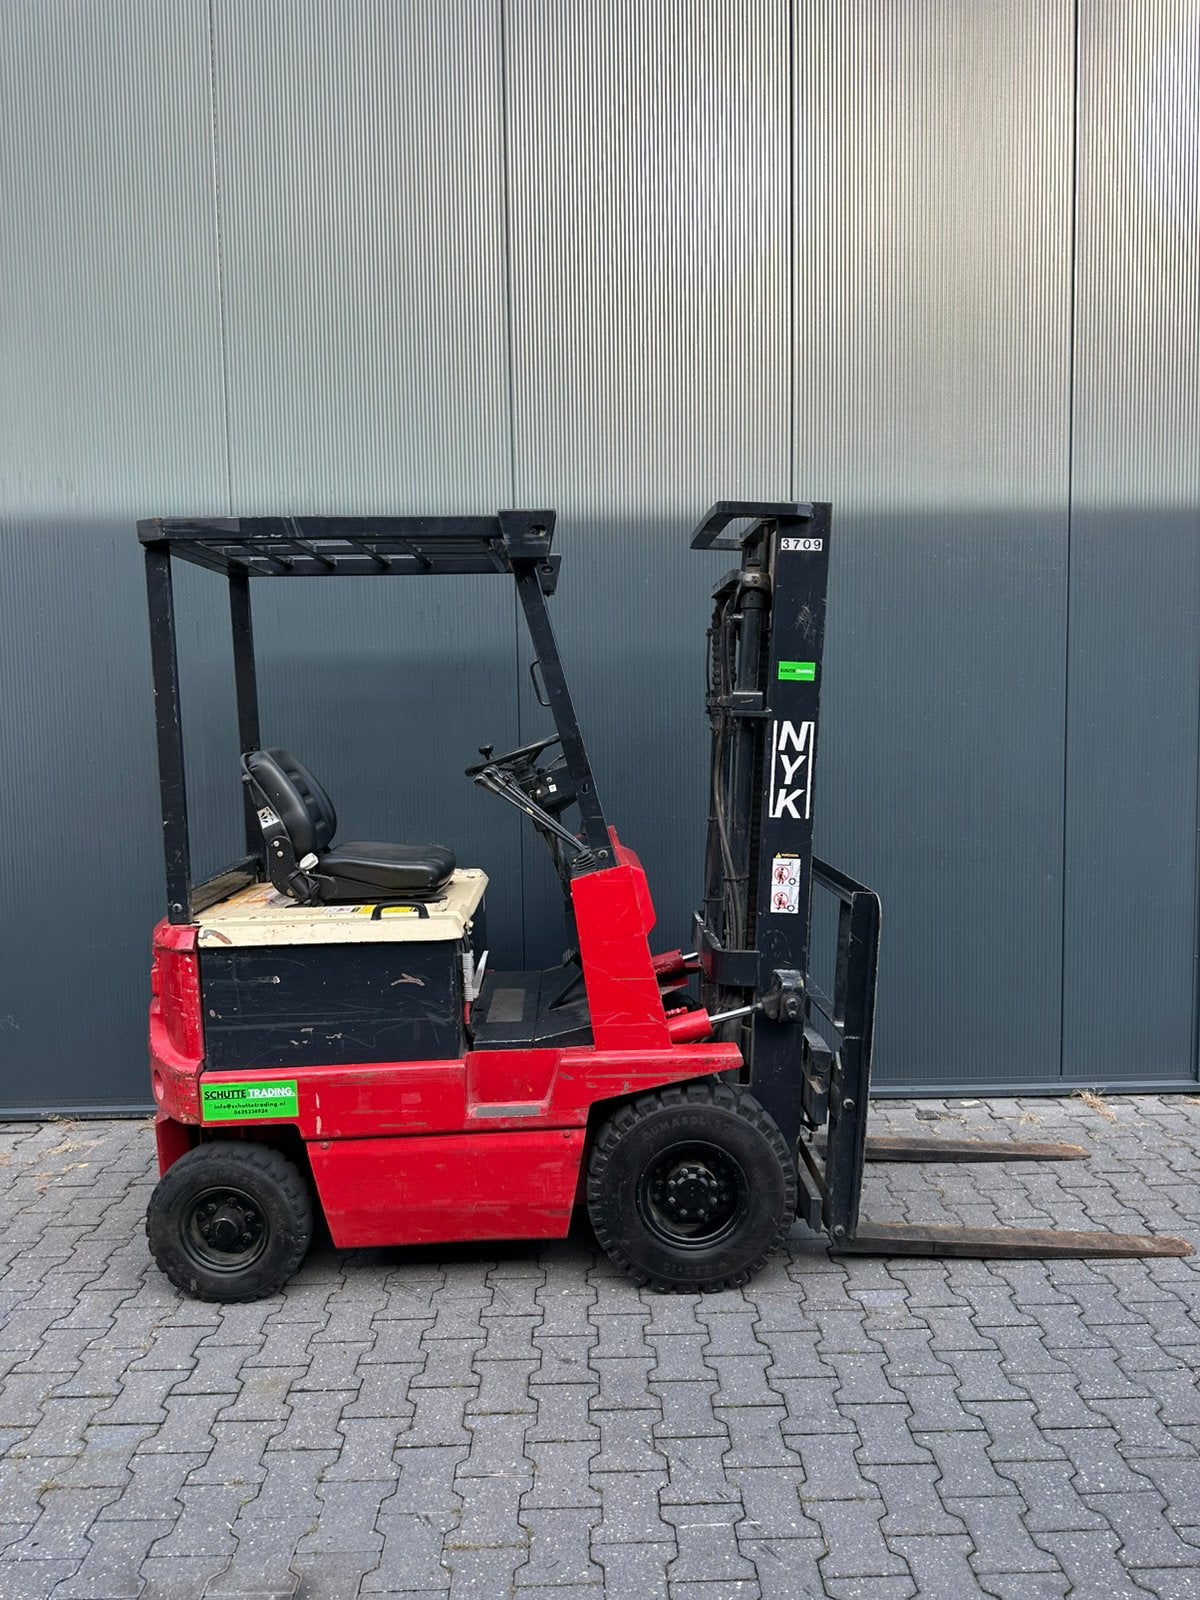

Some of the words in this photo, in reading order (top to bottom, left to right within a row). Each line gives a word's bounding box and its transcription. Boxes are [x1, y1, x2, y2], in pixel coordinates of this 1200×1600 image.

[782, 538, 821, 550] 3709
[774, 720, 809, 819] NYK
[204, 1089, 247, 1100] SCHUTTE
